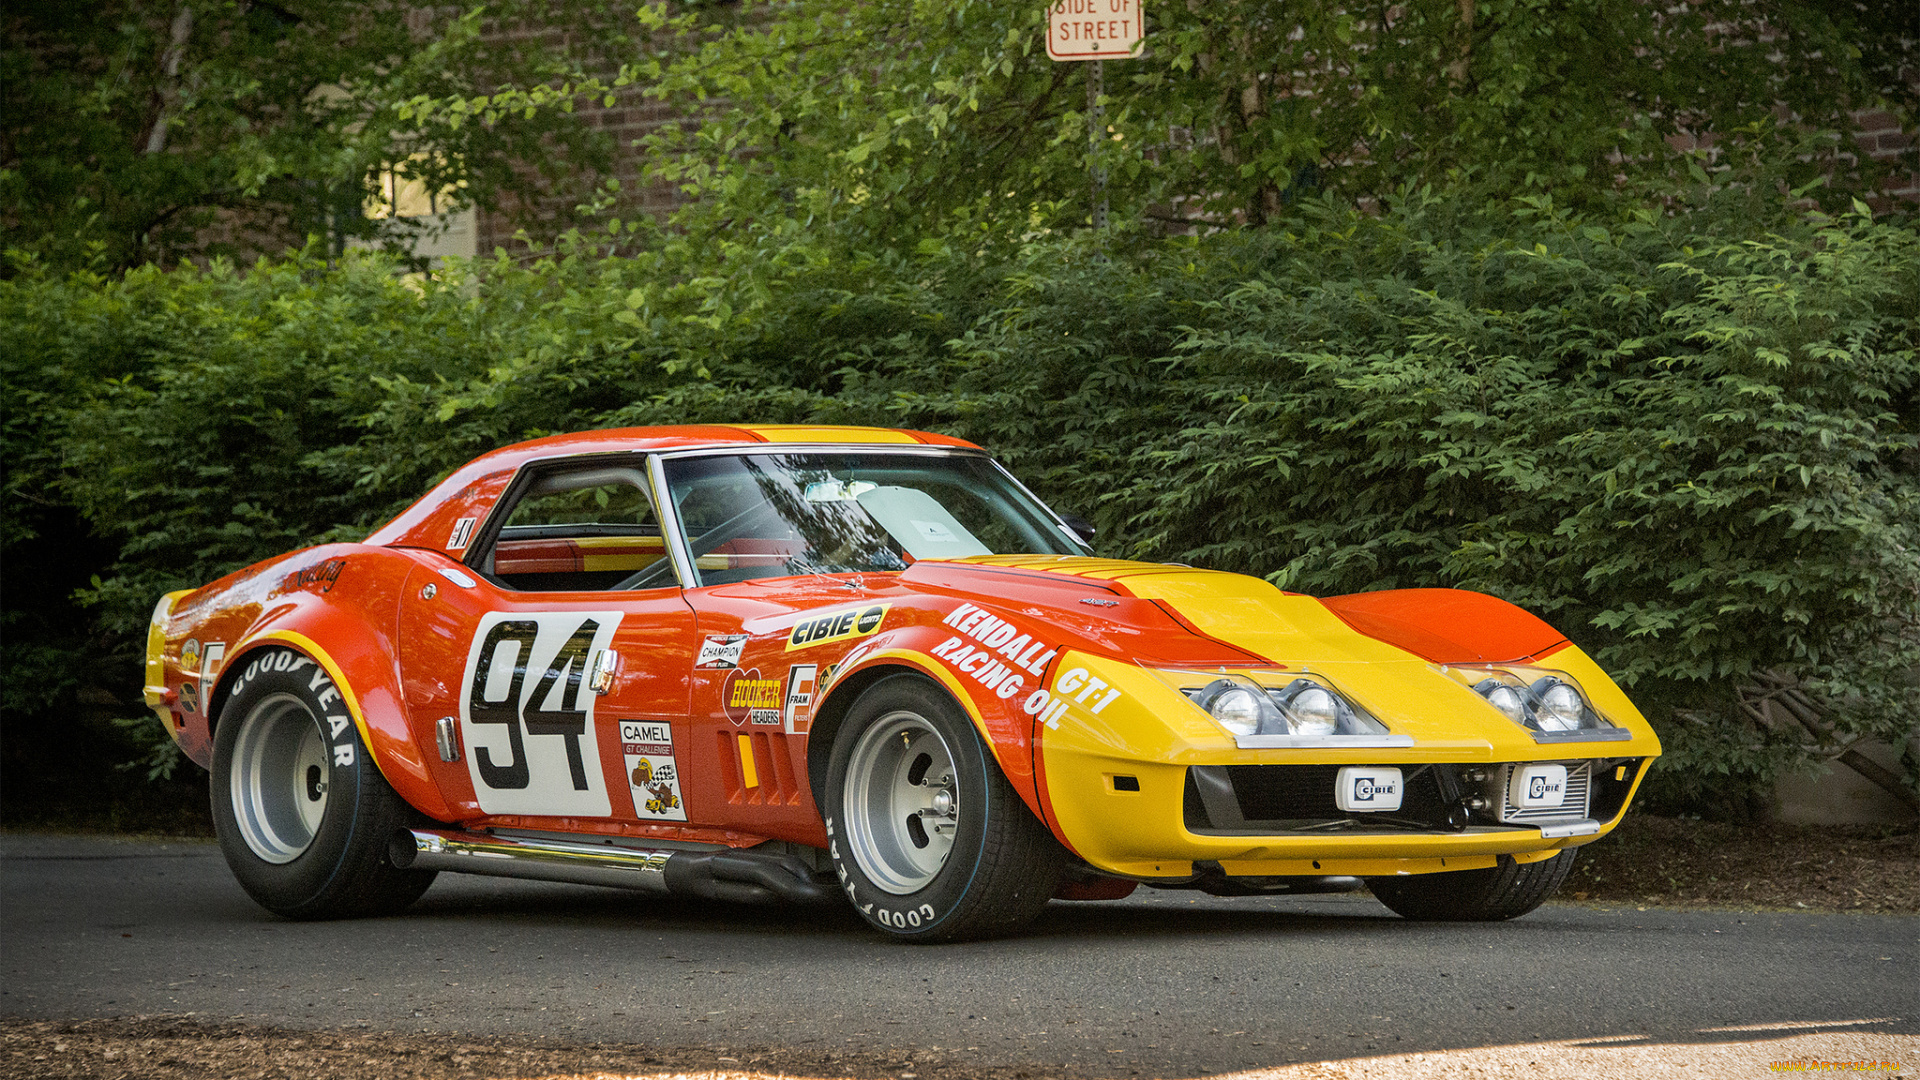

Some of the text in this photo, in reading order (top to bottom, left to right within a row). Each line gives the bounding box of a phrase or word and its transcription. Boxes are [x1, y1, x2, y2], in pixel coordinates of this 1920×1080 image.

[1060, 20, 1130, 41] STREET
[792, 611, 857, 646] CIBIE
[942, 602, 1057, 677] KENDALL
[702, 646, 740, 658] CHAMPION
[730, 679, 781, 708] HOOKER
[930, 636, 1070, 731] RACING OIL
[470, 618, 600, 791] 94
[790, 695, 808, 704] FRAM
[752, 710, 779, 724] HEADERS
[623, 725, 669, 742] CAMEL
[626, 744, 670, 755] GT CHALLENGE
